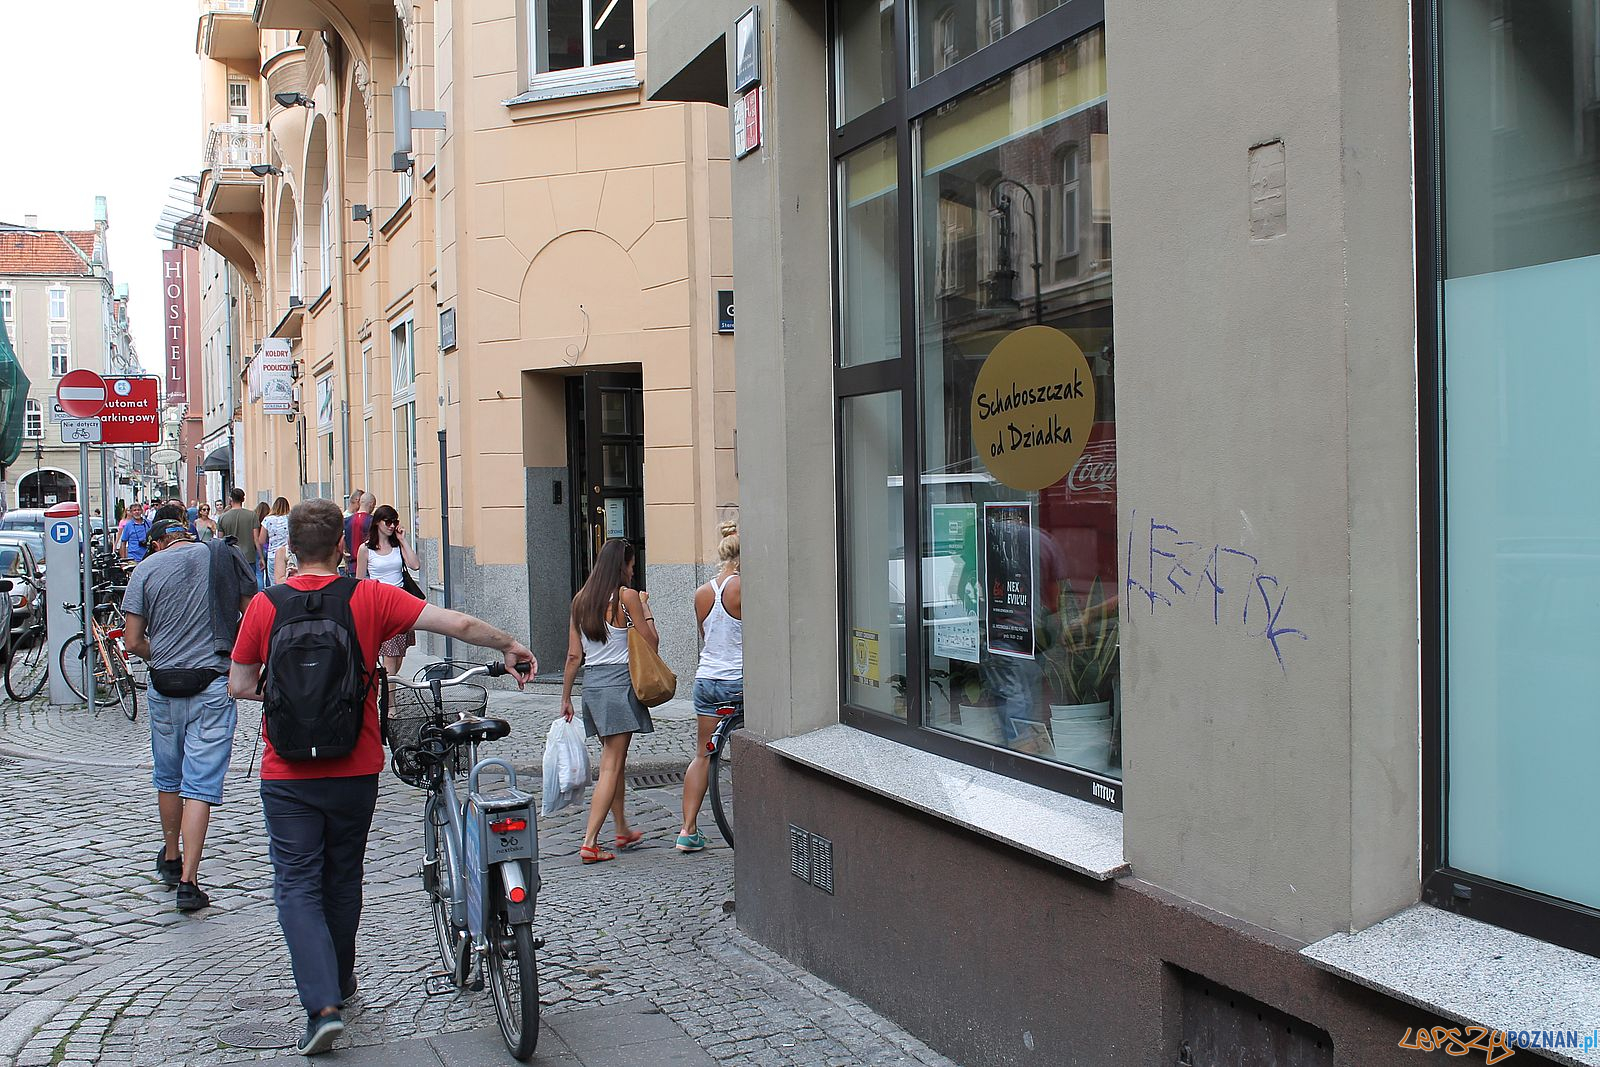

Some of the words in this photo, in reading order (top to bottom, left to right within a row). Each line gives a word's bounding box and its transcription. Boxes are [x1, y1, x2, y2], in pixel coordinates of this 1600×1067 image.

[164, 261, 182, 381] HOSTEL
[263, 364, 291, 372] PODUSZKI
[265, 350, 289, 358] KOŁDRY
[977, 367, 1084, 420] Schaboszczak
[990, 431, 1005, 457] od
[1008, 413, 1072, 451] Dziadka
[1068, 453, 1116, 491] Coca
[57, 525, 69, 541] P
